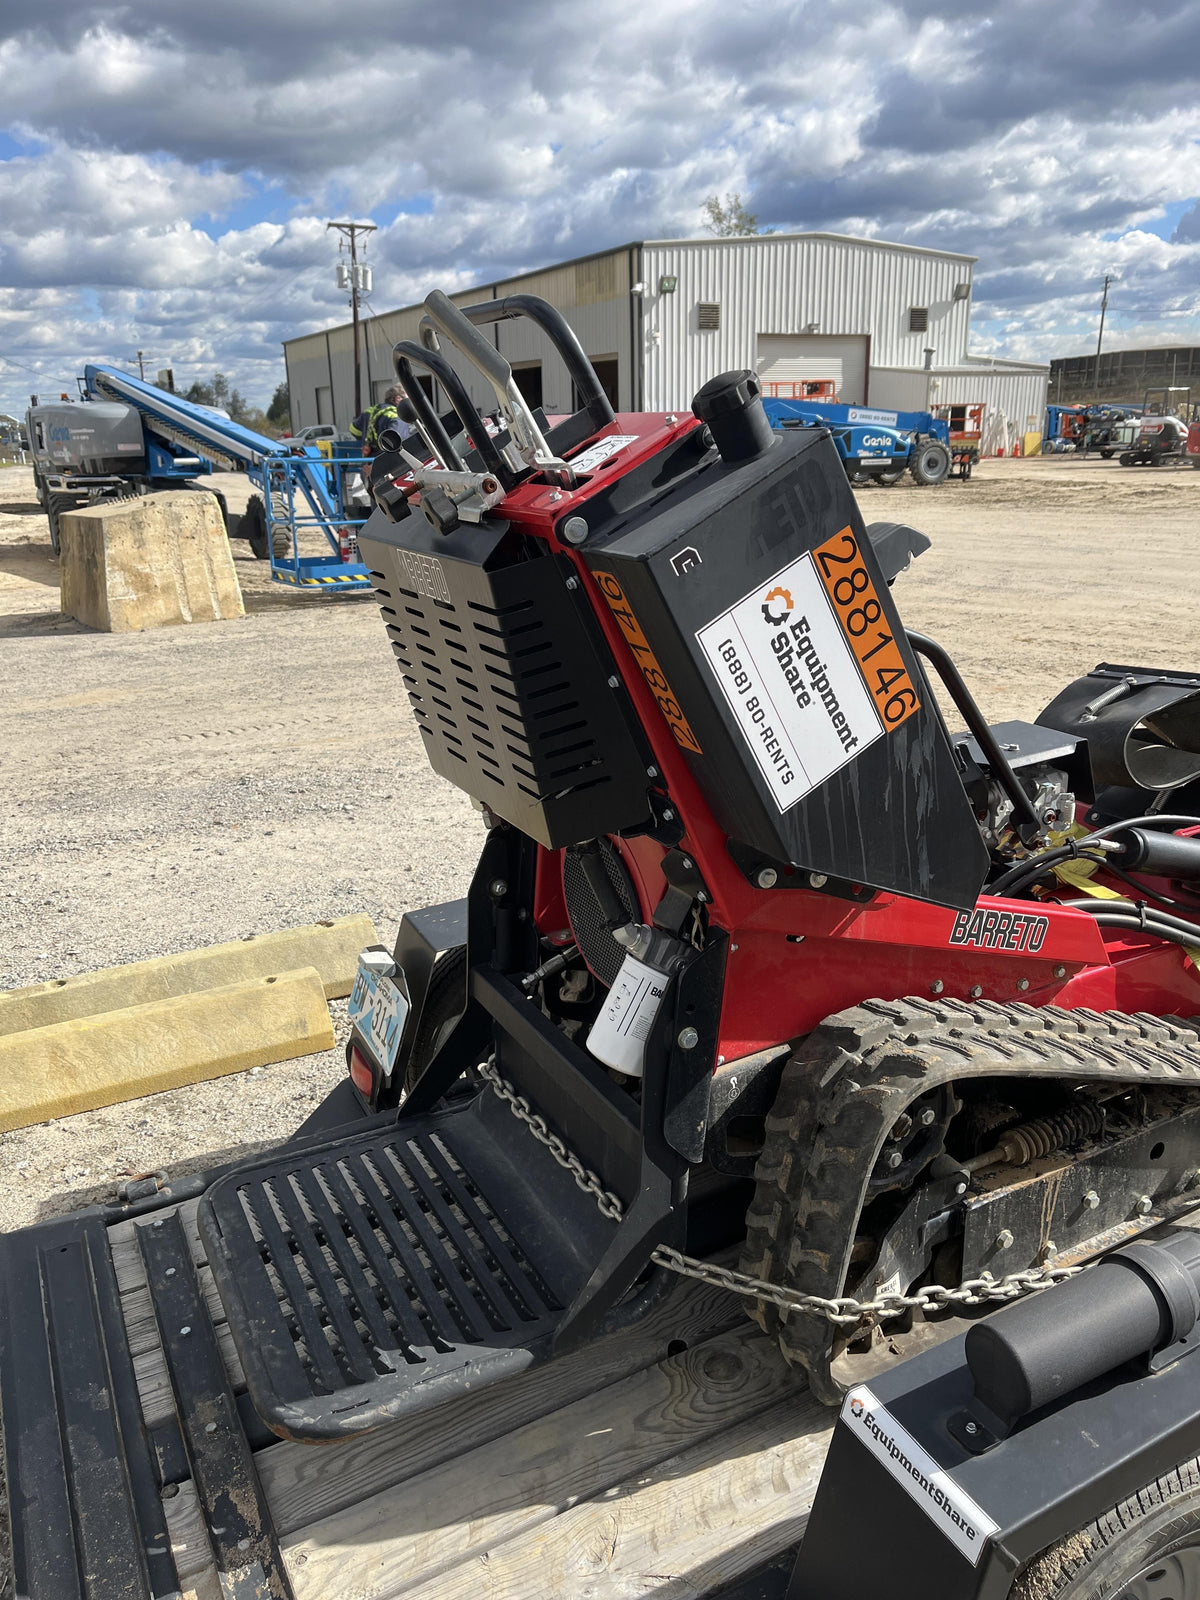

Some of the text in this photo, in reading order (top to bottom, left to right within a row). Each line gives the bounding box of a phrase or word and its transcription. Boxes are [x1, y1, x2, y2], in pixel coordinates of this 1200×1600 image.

[863, 434, 892, 446] Genie
[597, 575, 699, 750] 288146
[770, 631, 812, 709] Share
[790, 616, 859, 753] Equipment
[818, 536, 917, 723] 288146
[718, 638, 795, 786] (888) 80-RENTS
[948, 908, 1050, 953] BARRETO
[863, 1412, 976, 1541] EquipmentShare
